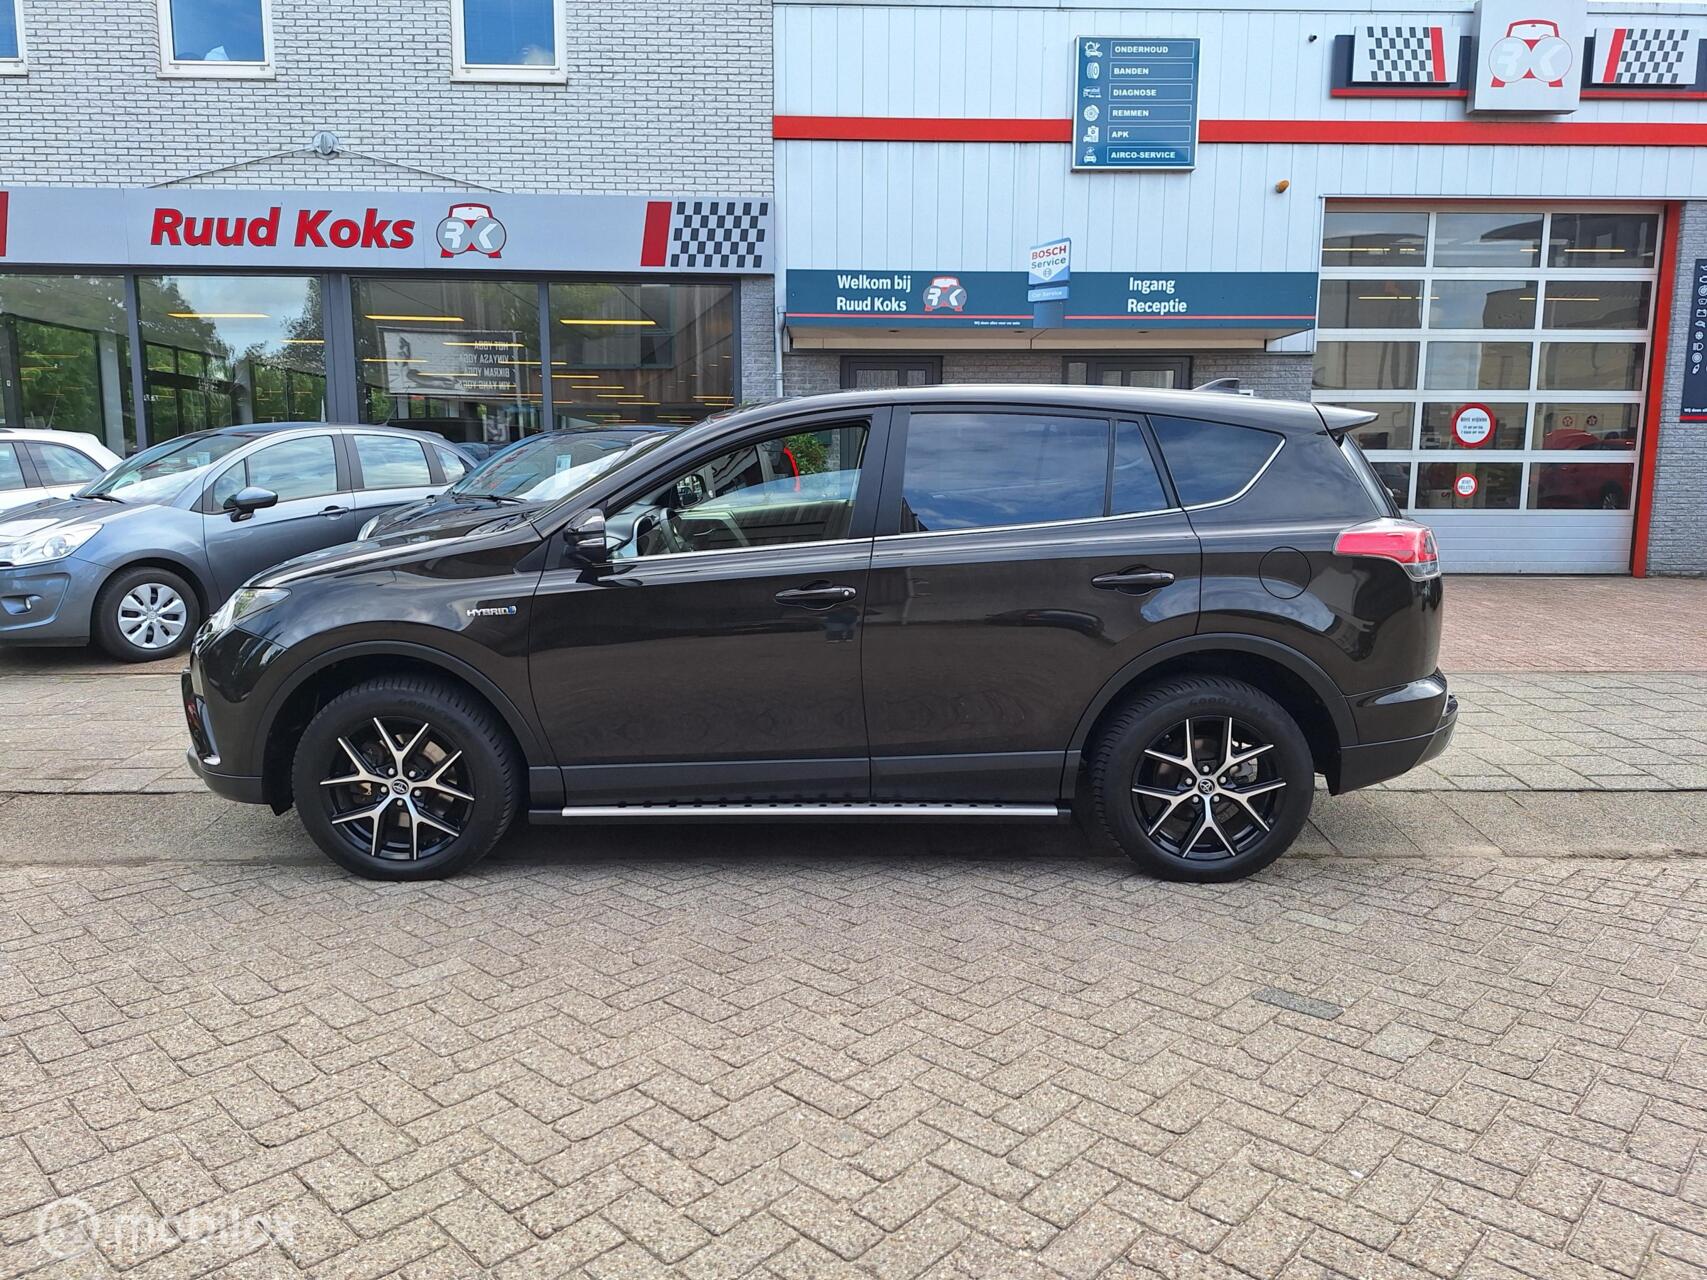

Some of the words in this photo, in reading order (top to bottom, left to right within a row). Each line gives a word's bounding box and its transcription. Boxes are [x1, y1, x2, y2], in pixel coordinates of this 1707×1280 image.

[1114, 46, 1169, 54] ONDERHOUD
[1113, 67, 1150, 75] BANDEN
[1113, 89, 1157, 97] DIAGNOSE
[1112, 109, 1150, 117] REMMEN
[1110, 151, 1176, 159] AIRCO-SERVICE
[150, 206, 281, 247] Ruud
[294, 208, 415, 249] Koks
[1031, 245, 1067, 260] BOSCH
[1031, 257, 1067, 270] Service
[837, 275, 892, 290] Welkom
[894, 275, 912, 293] bij
[1129, 277, 1176, 294] Ingang
[836, 297, 871, 312] Ruud
[874, 297, 907, 312] Koks
[1127, 299, 1188, 316] Receptie
[466, 607, 509, 616] HYBRID
